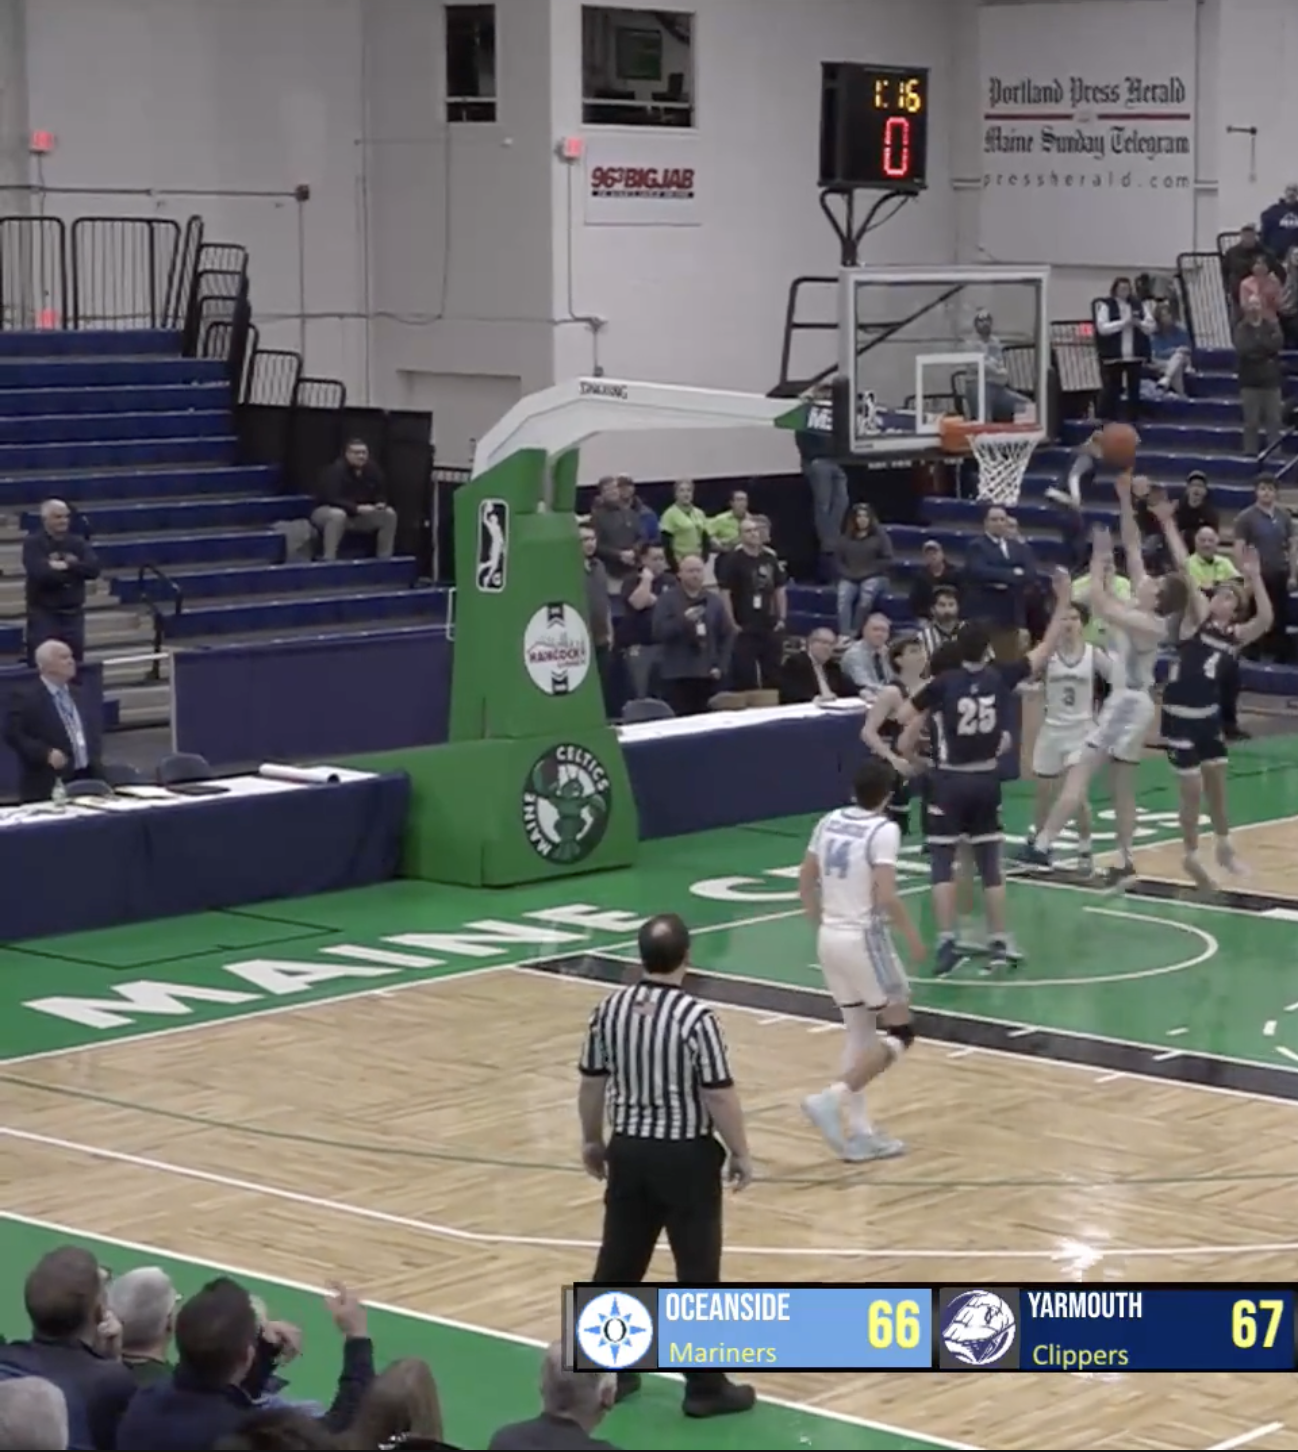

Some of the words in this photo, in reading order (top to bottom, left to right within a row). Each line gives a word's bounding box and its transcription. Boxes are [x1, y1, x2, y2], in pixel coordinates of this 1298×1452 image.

[875, 79, 921, 113] 1:16
[989, 77, 1063, 108] Portland
[1069, 76, 1120, 108] Press
[1124, 77, 1186, 109] Herald
[884, 117, 909, 175] 0
[984, 126, 1033, 153] Maine
[1041, 125, 1105, 160] Sunday
[1110, 126, 1190, 160] Telegram
[957, 694, 997, 736] 25
[556, 745, 610, 791] CELTICS
[523, 792, 552, 856] MAINE
[23, 903, 650, 1029] MAINE
